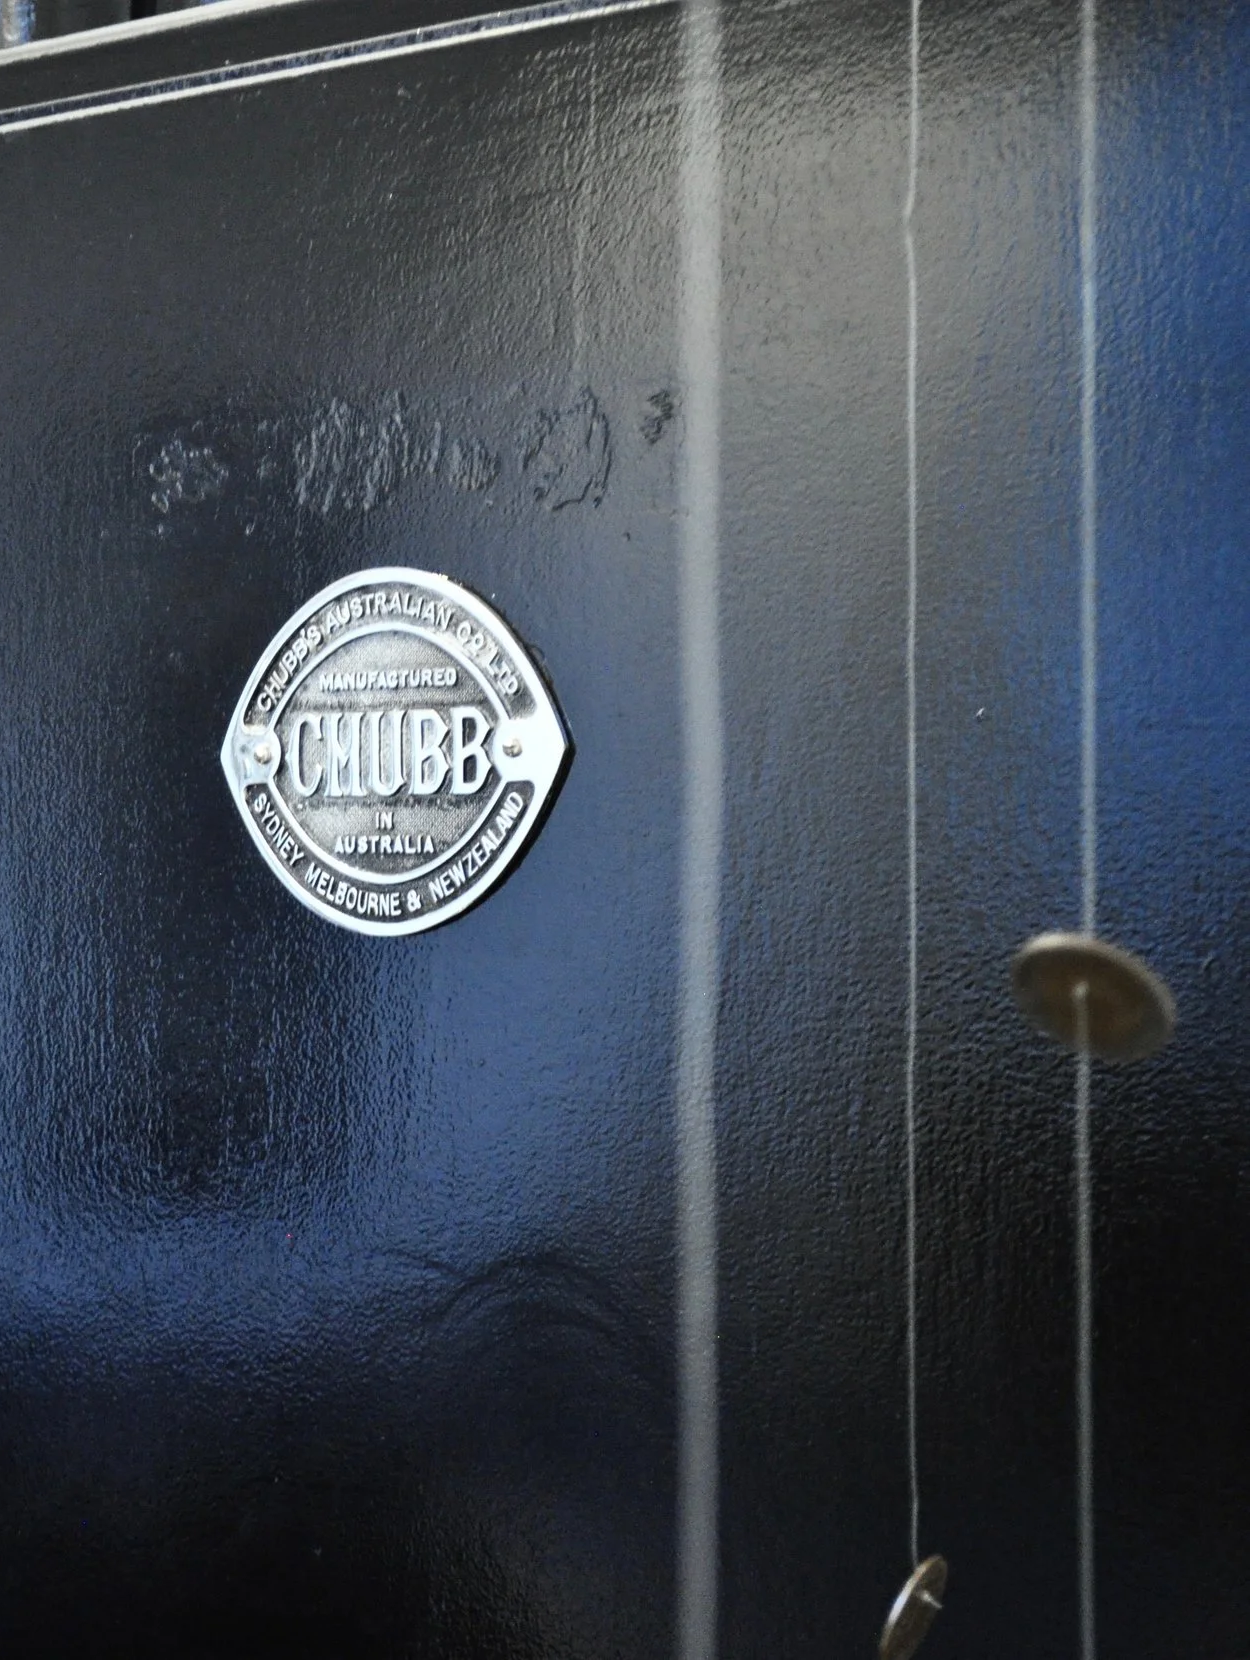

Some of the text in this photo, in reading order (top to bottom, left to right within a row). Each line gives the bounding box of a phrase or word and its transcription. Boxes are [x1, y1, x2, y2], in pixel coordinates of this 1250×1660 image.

[257, 626, 322, 712] CHUBB'S
[325, 591, 452, 636] AUSTRALIAN
[320, 667, 458, 692] MANUFACTURED
[287, 706, 493, 798] CHUBB
[335, 833, 434, 855] AUSTRALIA
[375, 811, 393, 830] IN
[253, 793, 304, 868] SYDNEY
[305, 866, 401, 918] MELBOURNE
[406, 889, 422, 909] &
